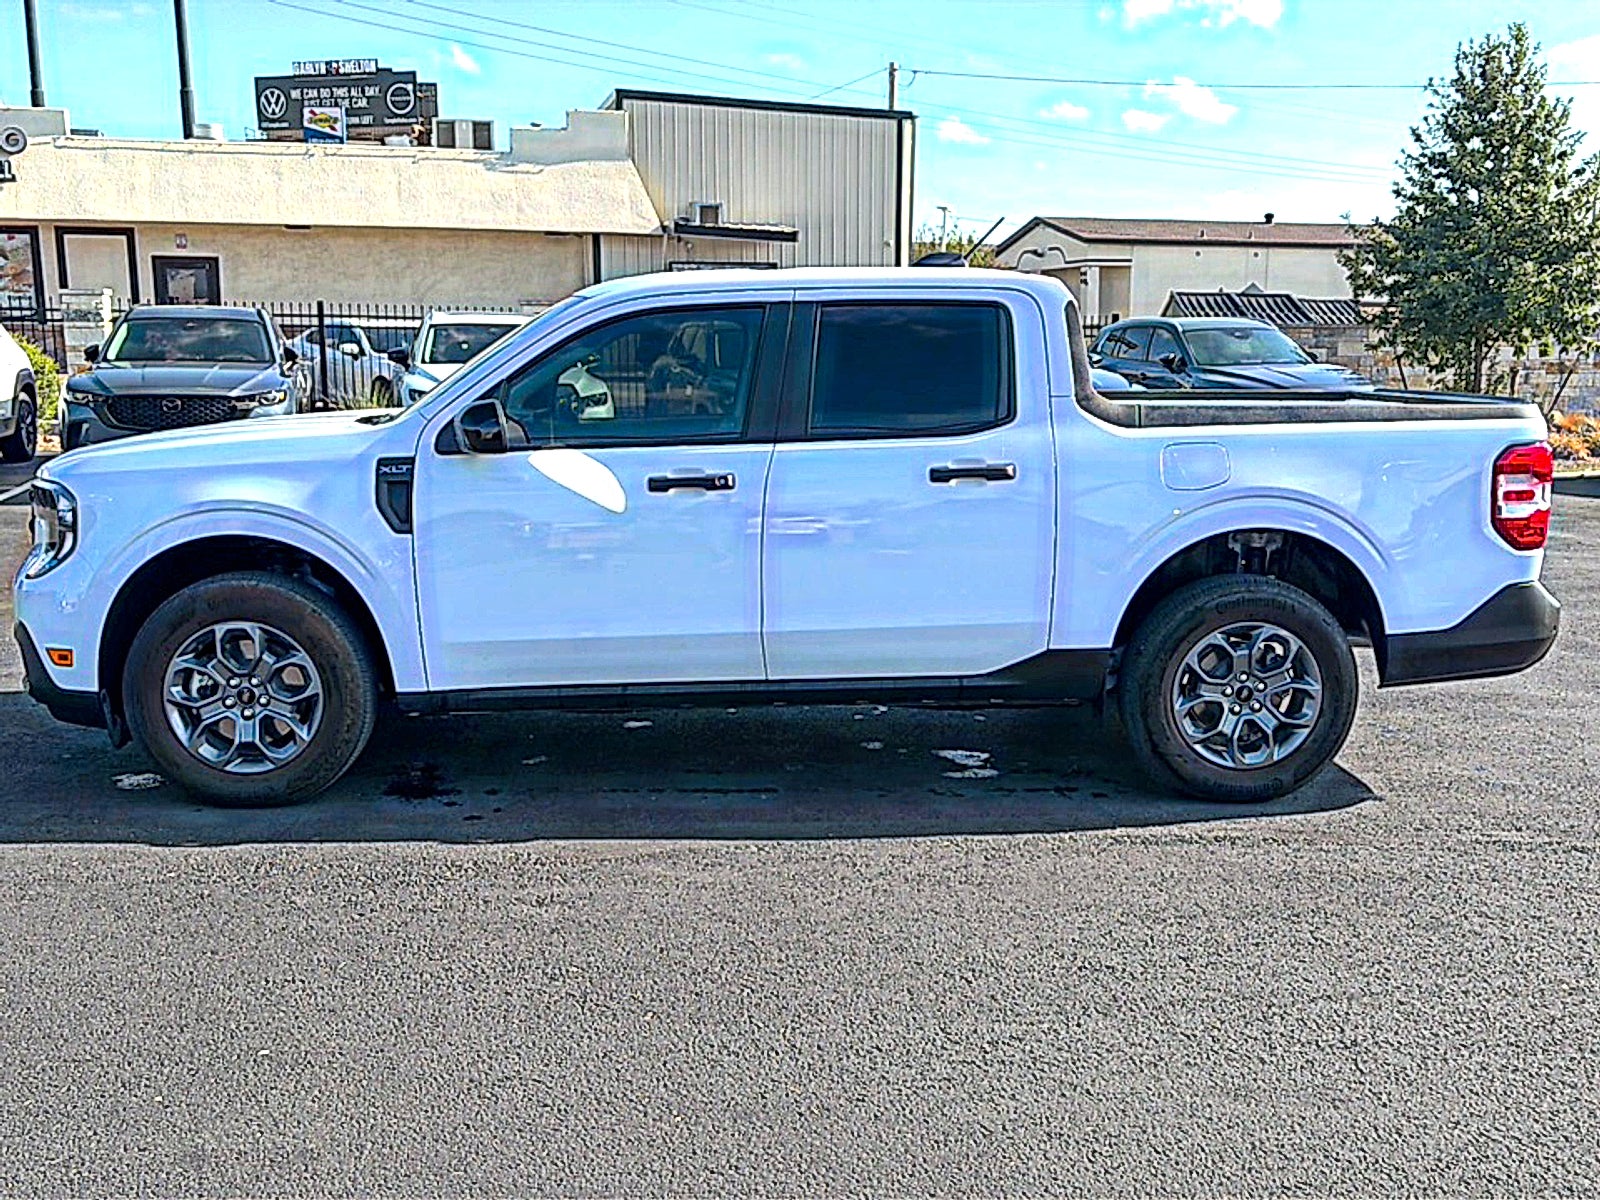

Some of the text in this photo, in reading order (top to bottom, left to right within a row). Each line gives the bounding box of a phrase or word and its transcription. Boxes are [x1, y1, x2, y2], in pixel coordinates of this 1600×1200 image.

[290, 88, 302, 99] WE
[303, 88, 318, 99] CAN
[320, 87, 331, 98] DO
[332, 86, 349, 97] THIS
[350, 86, 363, 97] ALL
[379, 464, 412, 473] XLT
